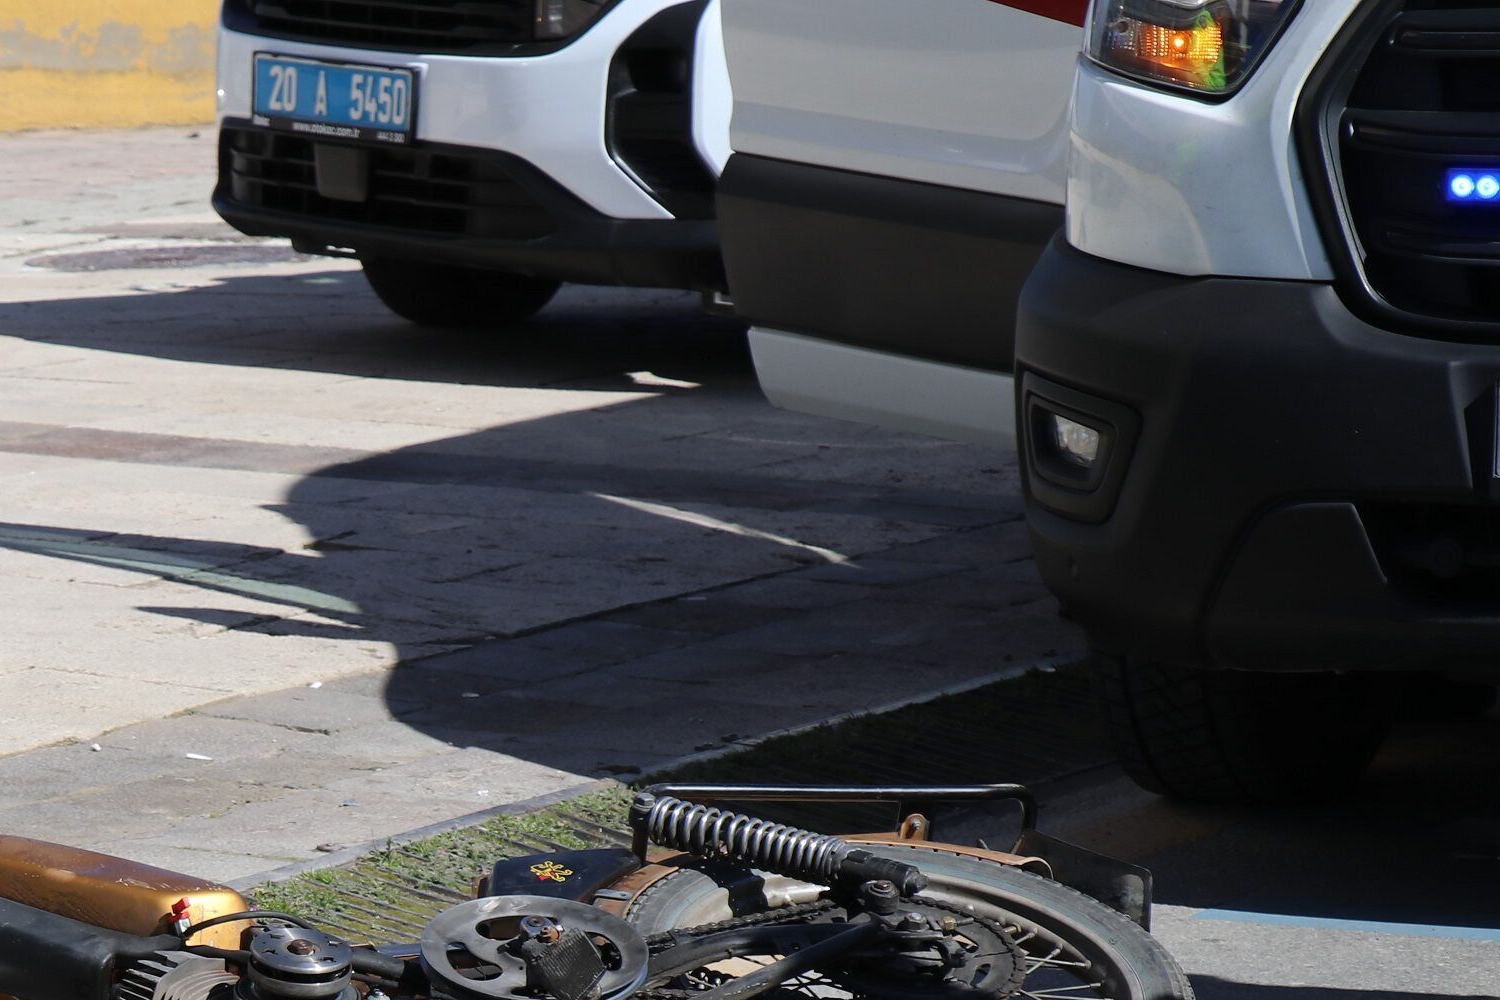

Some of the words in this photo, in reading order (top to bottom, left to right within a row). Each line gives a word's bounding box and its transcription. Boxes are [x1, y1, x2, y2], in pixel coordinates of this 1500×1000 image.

[269, 65, 297, 112] 20
[315, 70, 327, 116] A
[350, 73, 406, 125] 5450
